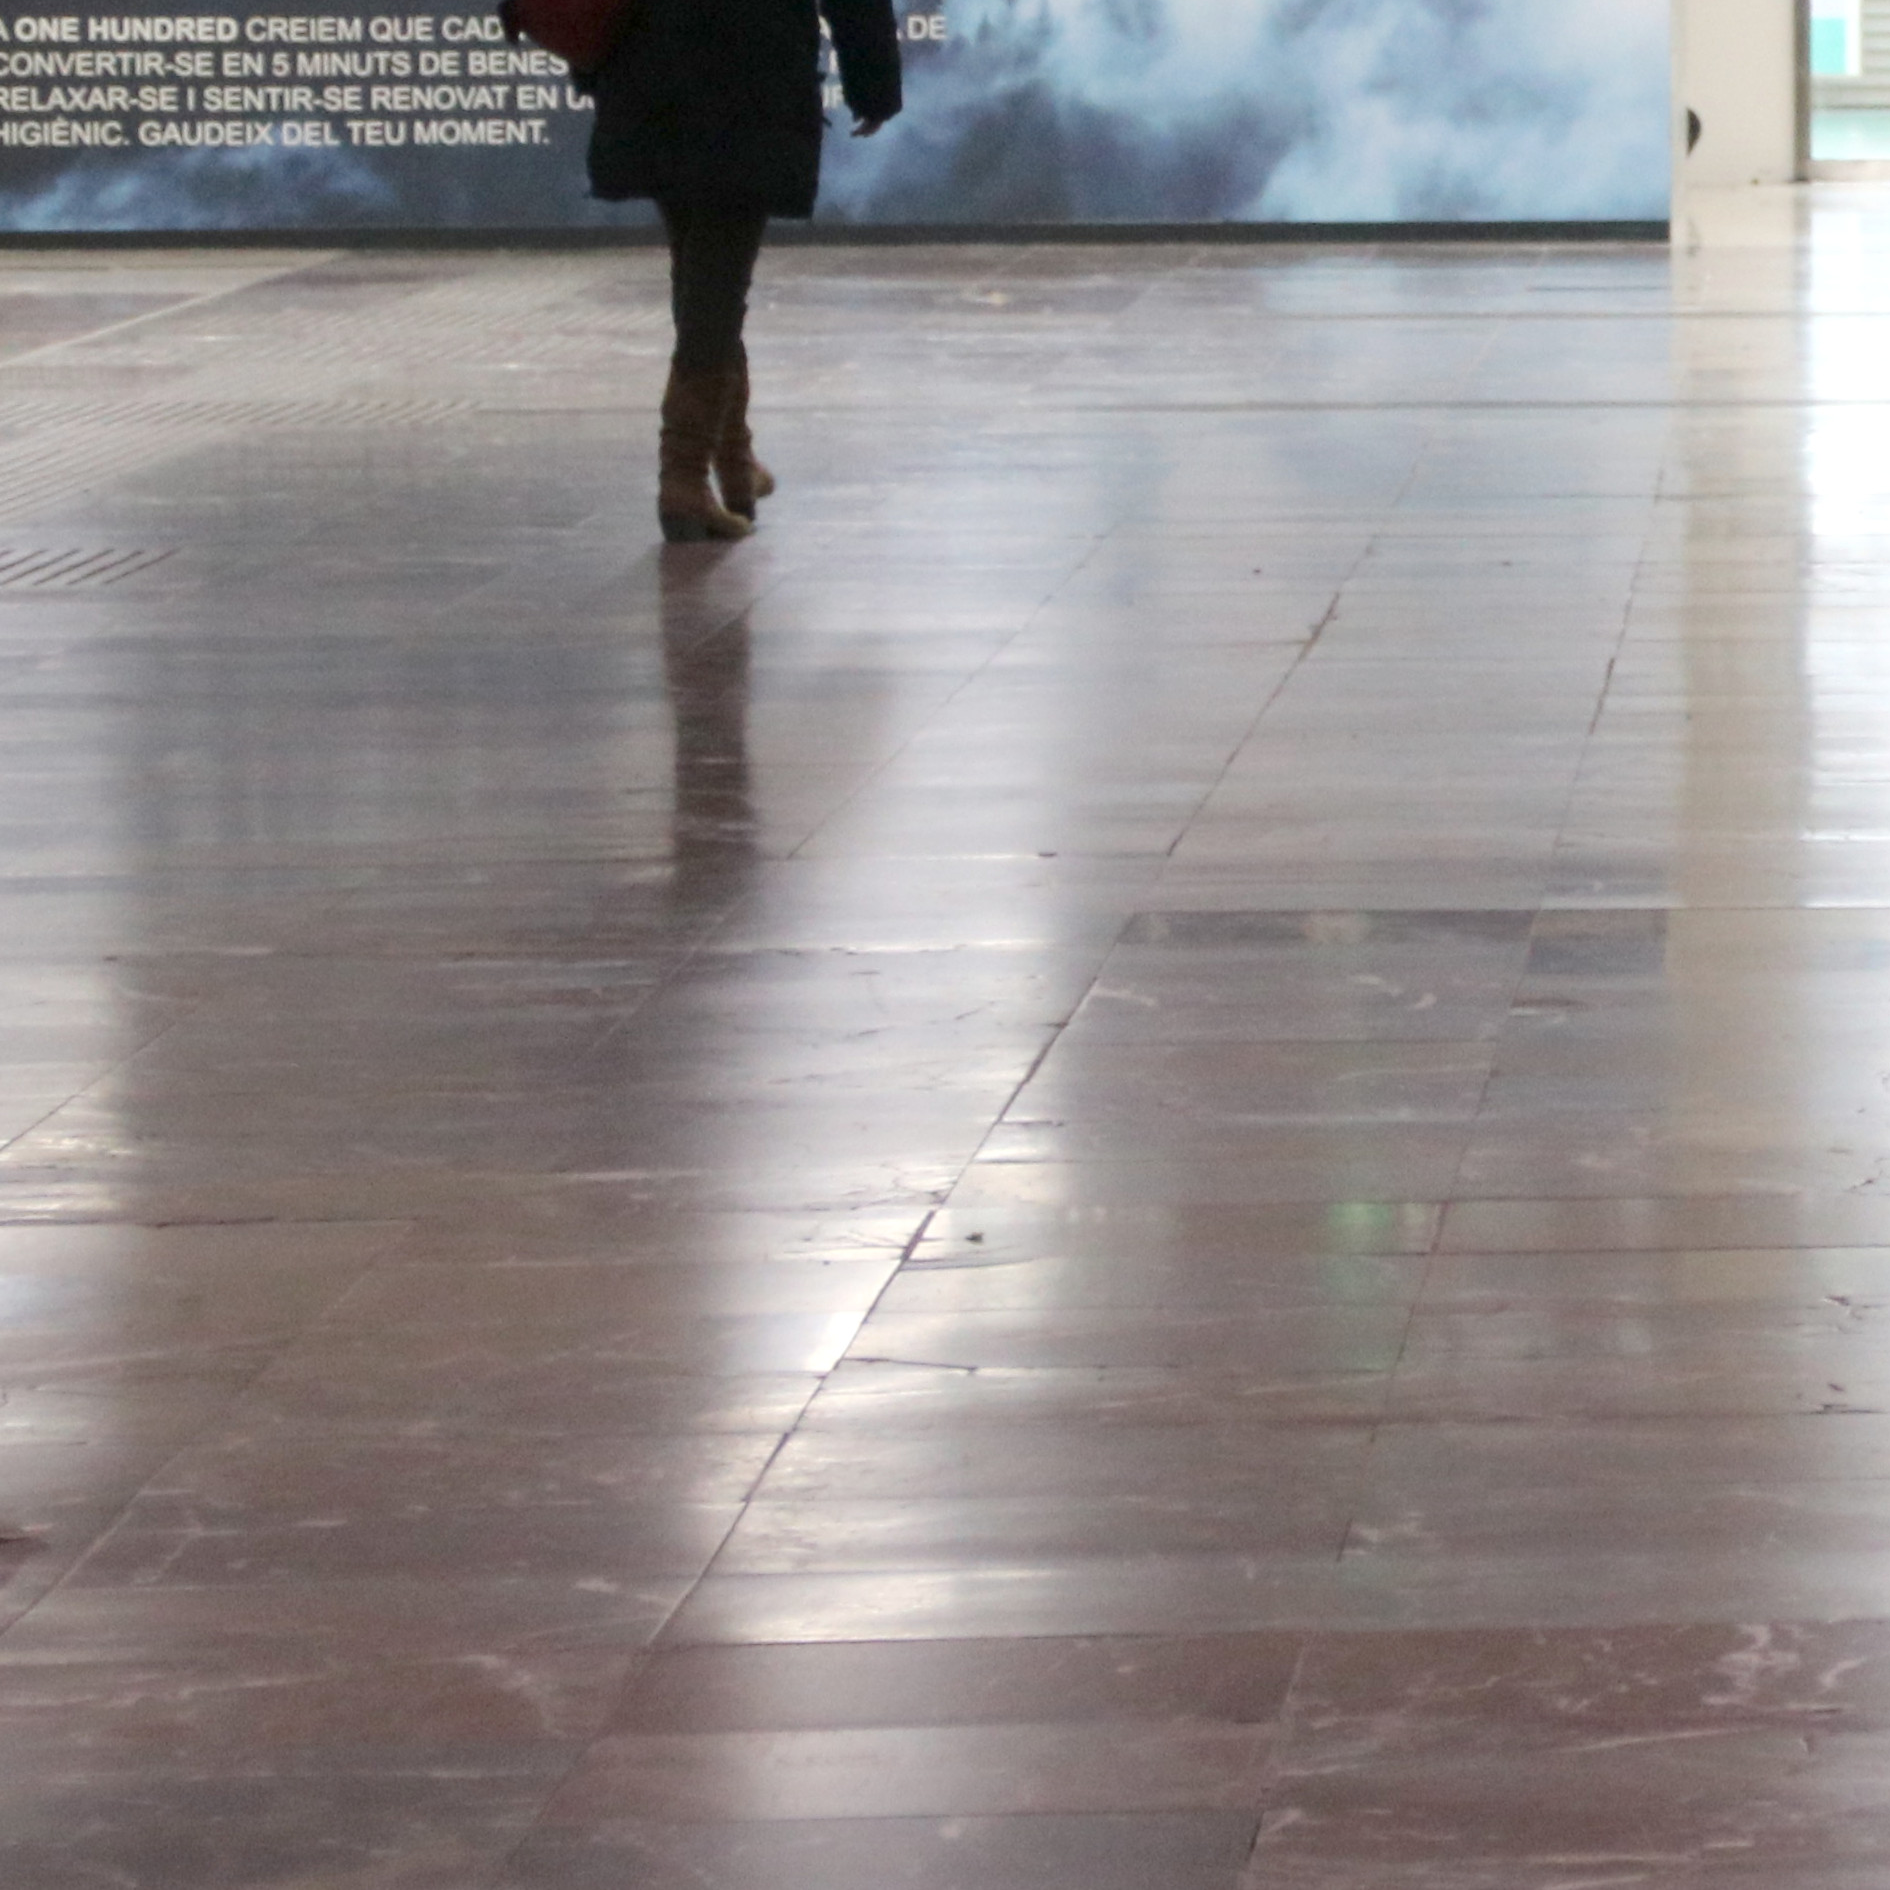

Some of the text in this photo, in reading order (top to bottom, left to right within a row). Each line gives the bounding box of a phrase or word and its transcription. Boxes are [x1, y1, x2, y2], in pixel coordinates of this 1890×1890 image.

[14, 16, 80, 43] ONE
[88, 16, 239, 42] HUNDRED
[245, 16, 362, 43] CREIEM
[369, 16, 434, 43] QUE
[441, 16, 504, 43] CAD
[222, 51, 264, 77] EN
[272, 51, 290, 77] 5
[298, 51, 411, 77] MINUTS
[419, 50, 460, 77] DE
[468, 50, 569, 77] BENES
[187, 86, 195, 111] I
[203, 85, 362, 111] SENTIR-SE
[371, 85, 510, 111] RENOVAT
[517, 85, 557, 111] EN
[138, 120, 275, 147] GAUDEIX
[282, 120, 341, 147] DEL
[348, 120, 405, 146] TEU
[413, 120, 551, 146] MOMENT.
